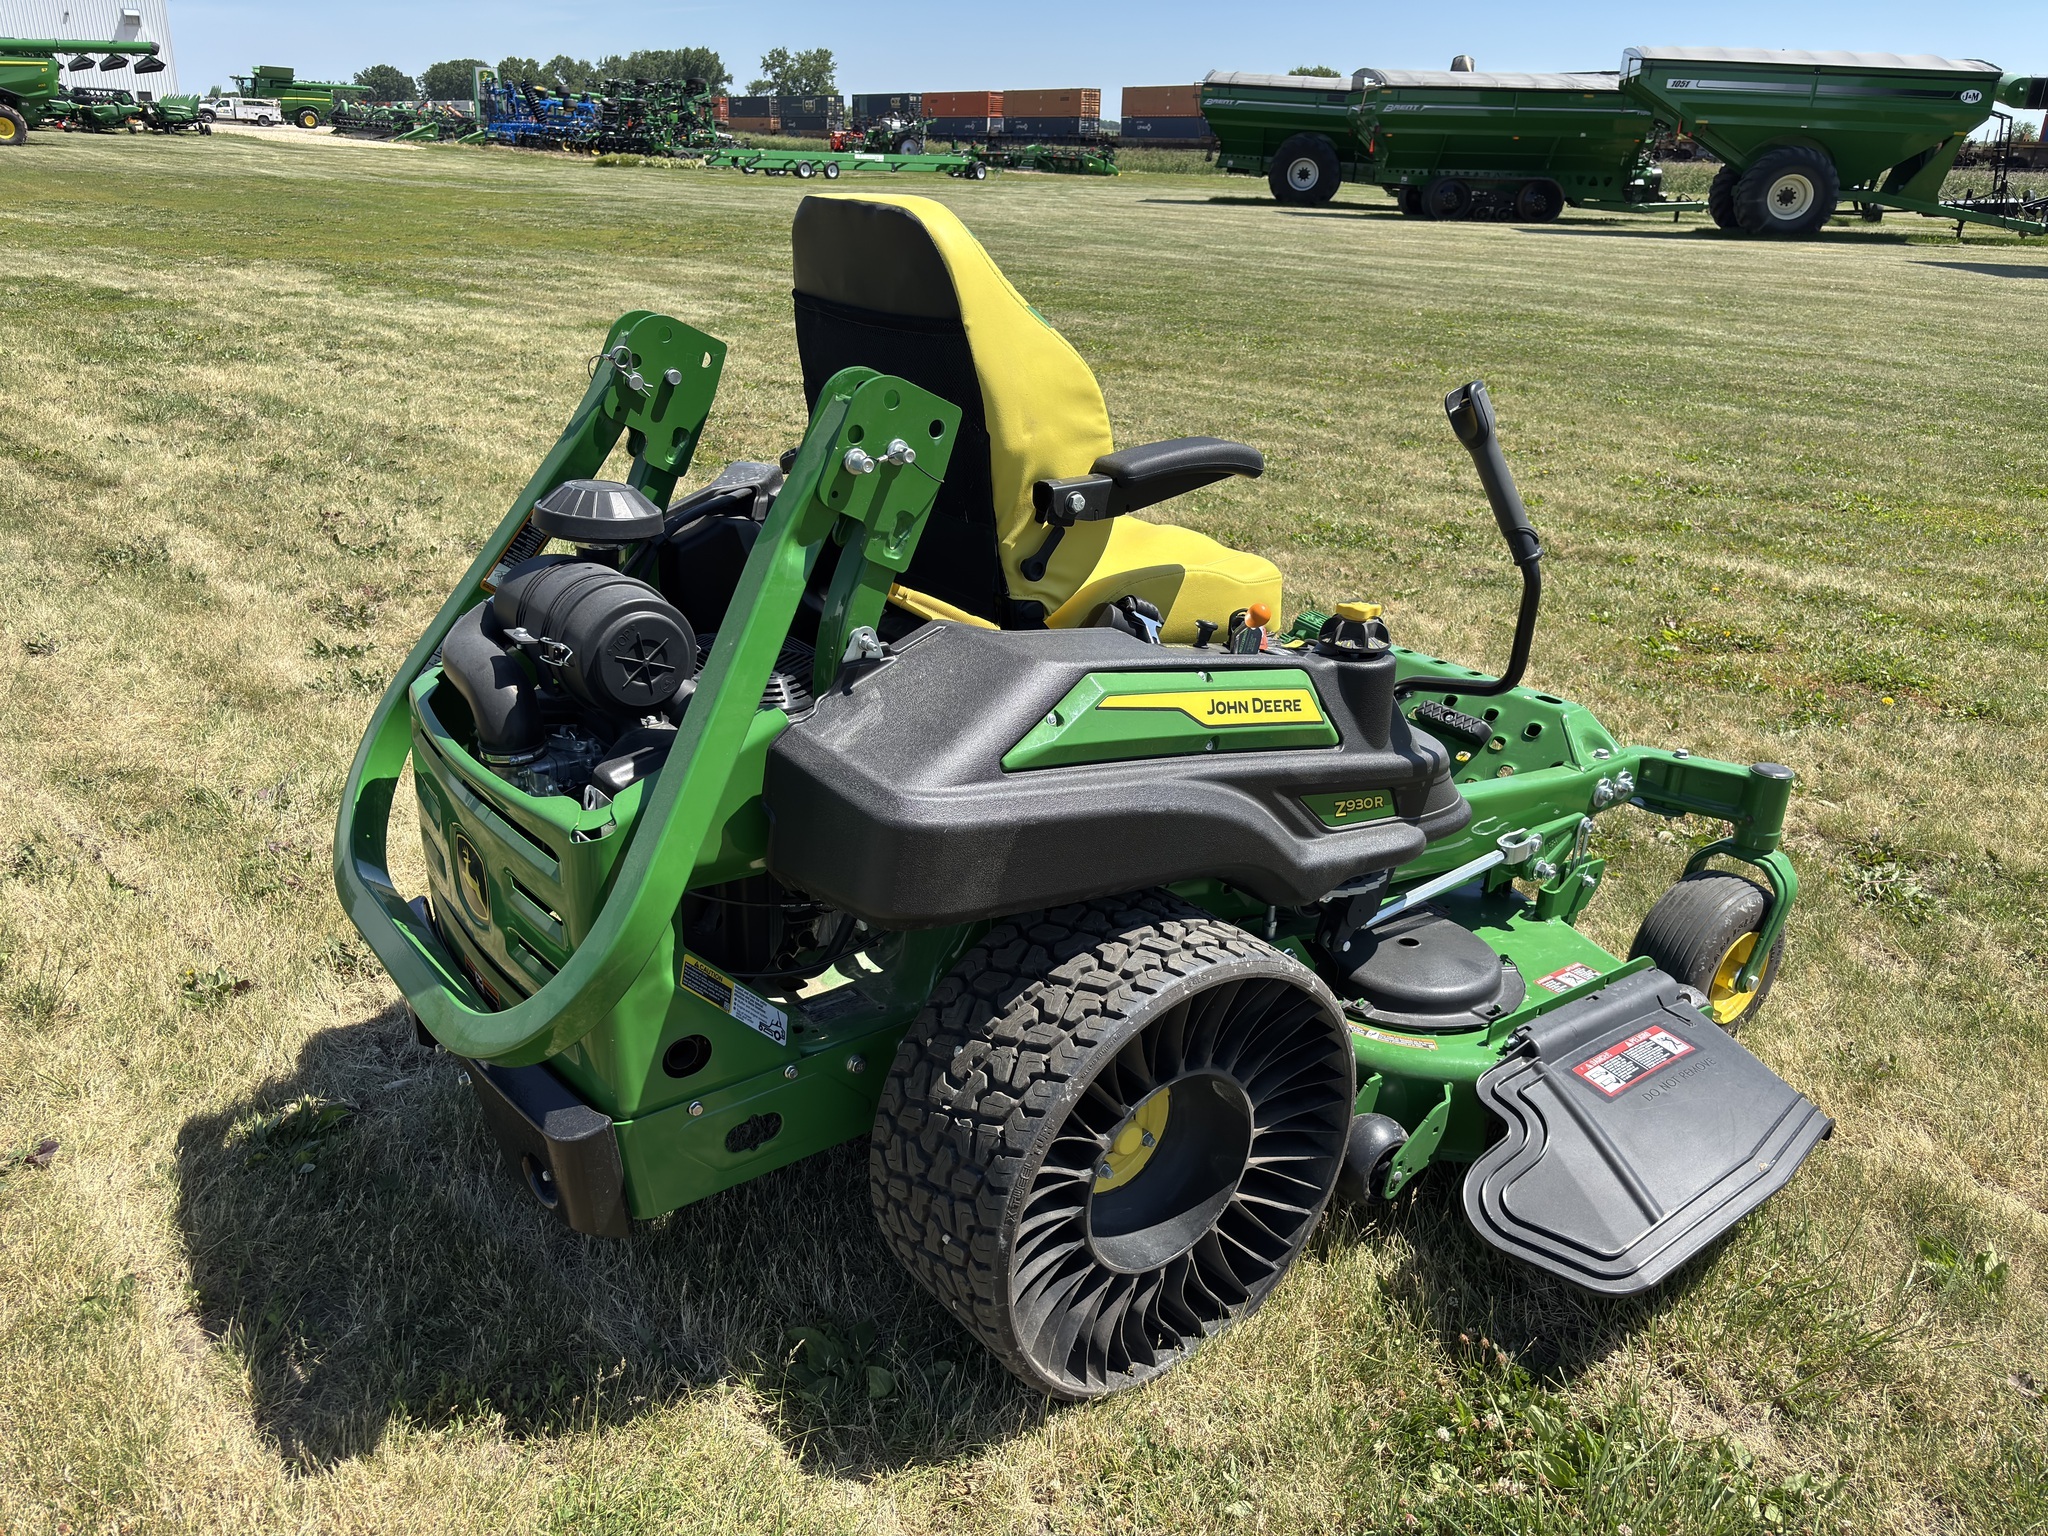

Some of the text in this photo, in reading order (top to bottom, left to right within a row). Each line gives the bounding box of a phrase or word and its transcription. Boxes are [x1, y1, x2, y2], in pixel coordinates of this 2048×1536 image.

[1671, 80, 1690, 88] 1051
[1962, 92, 1980, 101] J&M
[1383, 104, 1419, 112] BRENT
[1207, 698, 1302, 715] JOHN DEERE
[1335, 796, 1384, 817] Z930R
[699, 964, 724, 982] CAUTION
[1641, 1057, 1717, 1102] DO NOT REMOVE
